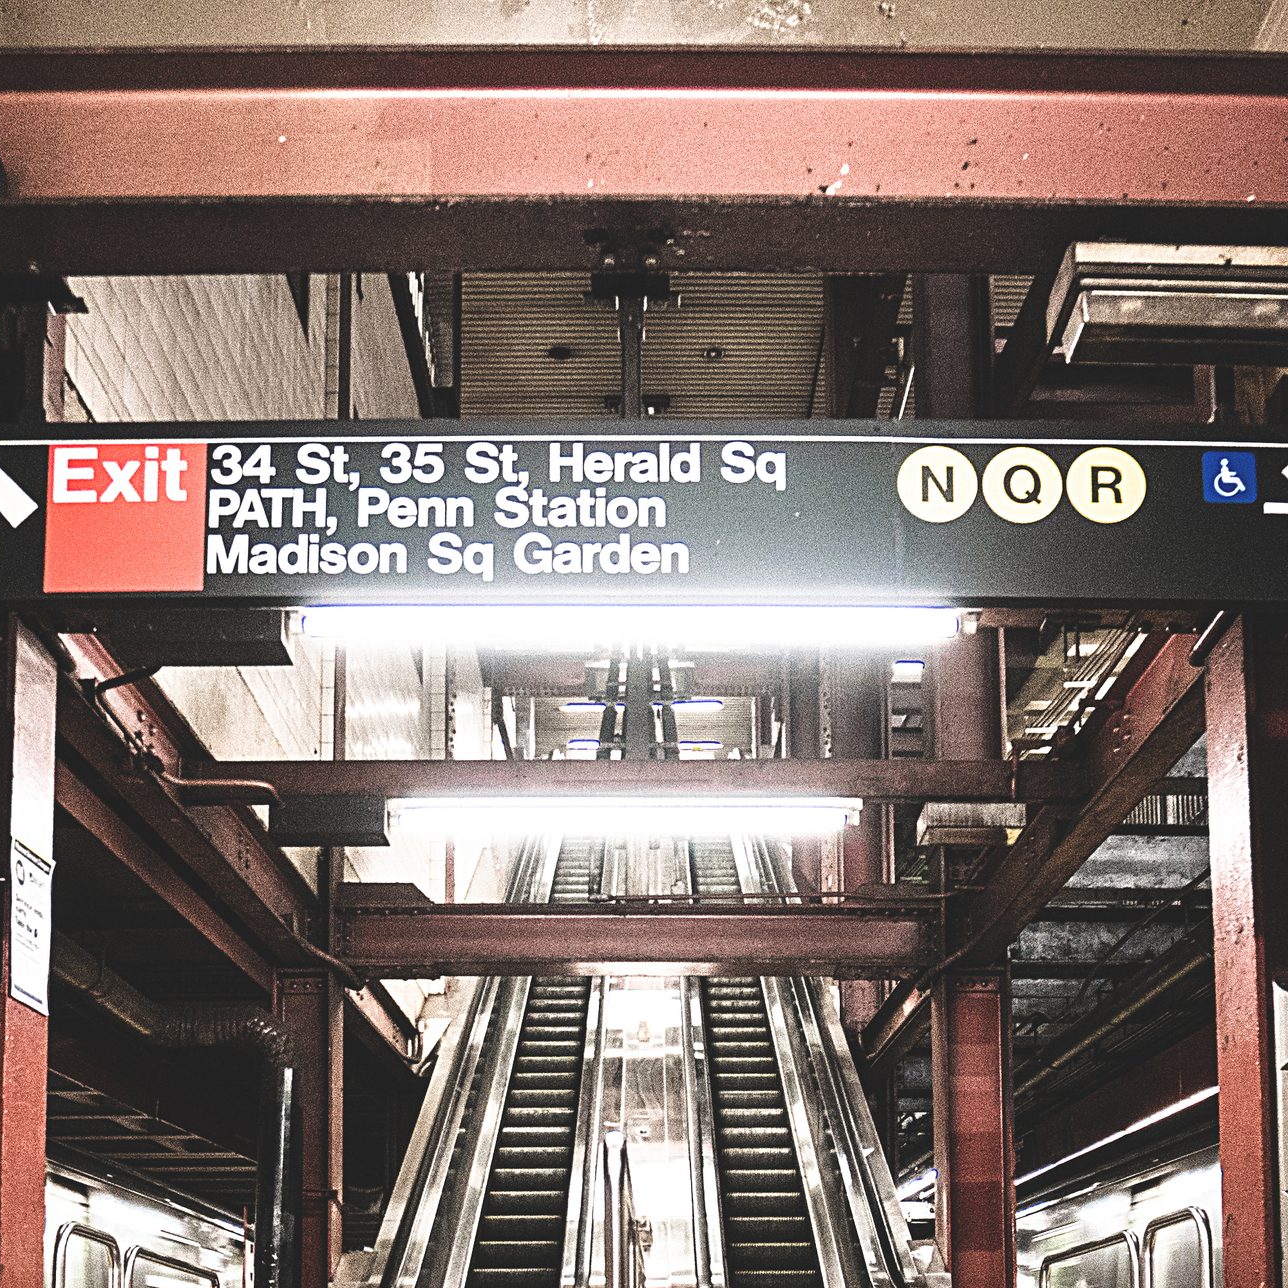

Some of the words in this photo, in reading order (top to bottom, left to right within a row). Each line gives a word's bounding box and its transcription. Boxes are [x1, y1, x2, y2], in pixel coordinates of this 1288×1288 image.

[52, 446, 188, 503] Exit
[210, 443, 276, 485] 34
[295, 443, 360, 492] St,
[379, 441, 445, 484] 35
[464, 441, 530, 491] St,
[549, 441, 701, 483] Herald
[720, 441, 788, 491] Sq
[920, 465, 955, 503] N
[1003, 464, 1042, 505] Q
[1090, 465, 1123, 504] R
[208, 487, 339, 536] PATH,
[357, 487, 475, 528] Penn
[493, 486, 667, 529] Station
[205, 534, 408, 575] Madison
[427, 531, 495, 582] Sq
[513, 531, 690, 574] Garden
